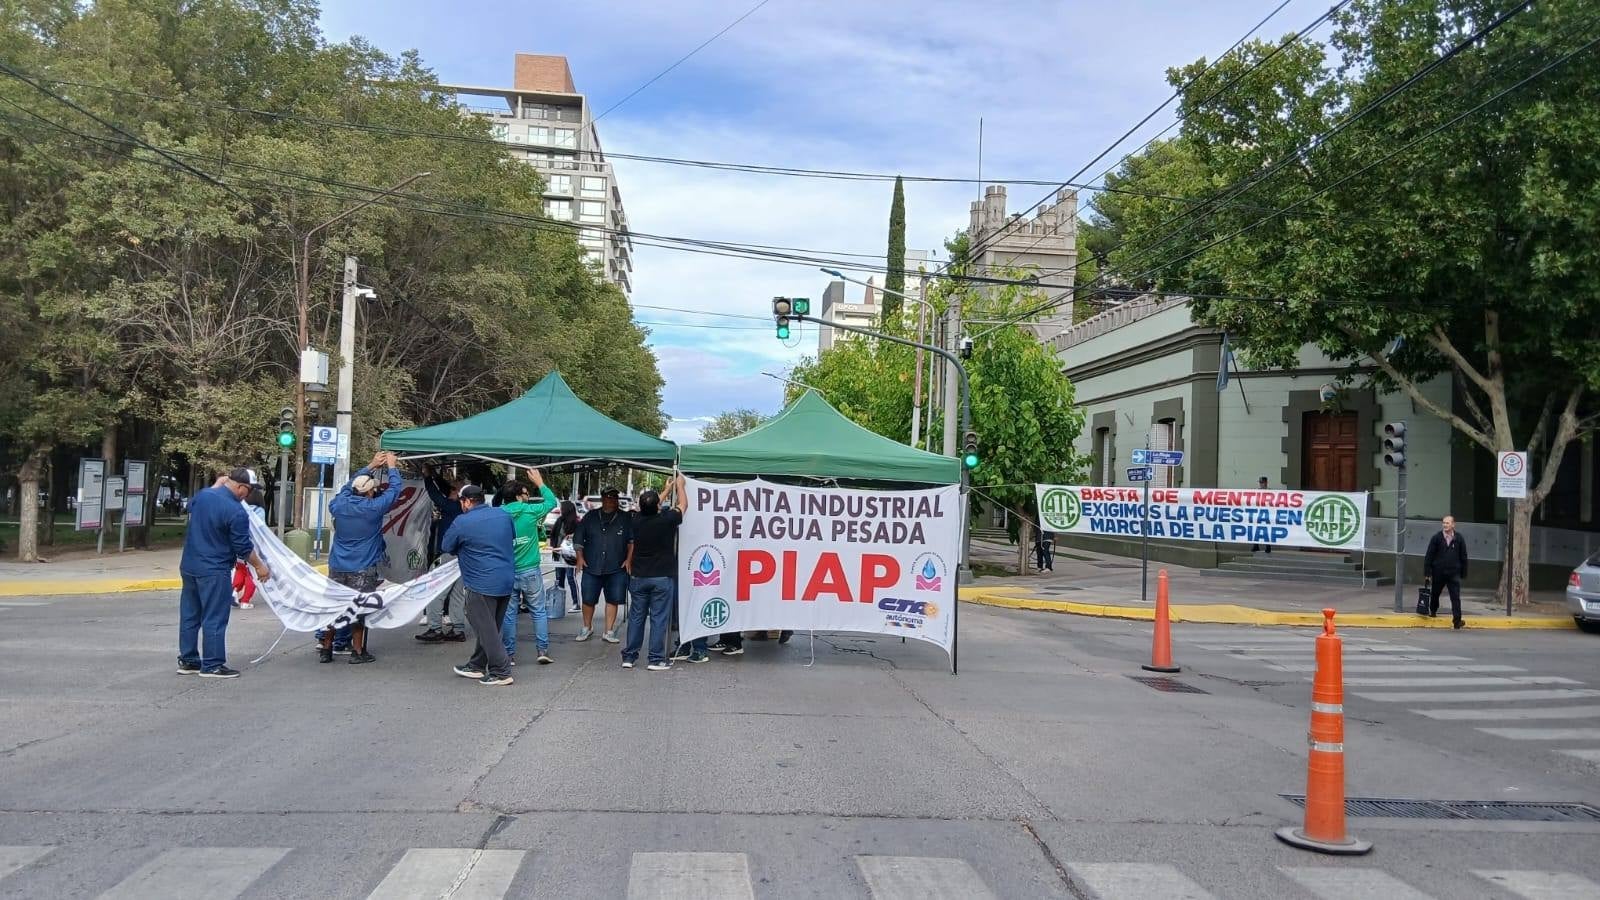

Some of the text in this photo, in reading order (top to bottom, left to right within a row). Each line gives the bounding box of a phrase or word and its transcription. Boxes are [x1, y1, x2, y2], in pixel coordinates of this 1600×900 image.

[321, 431, 329, 439] E
[697, 487, 944, 518] PLANTA INDUSTRIAL
[1080, 488, 1303, 507] BASTA DE MENTIRAS
[1081, 502, 1302, 525] EXIGIMOS LA PUESTA EN
[713, 516, 926, 544] DE AGUA PESADA
[1090, 518, 1288, 542] MARCHA DE LA PIAP
[1305, 521, 1338, 533] PIAP
[736, 549, 901, 603] PIAP
